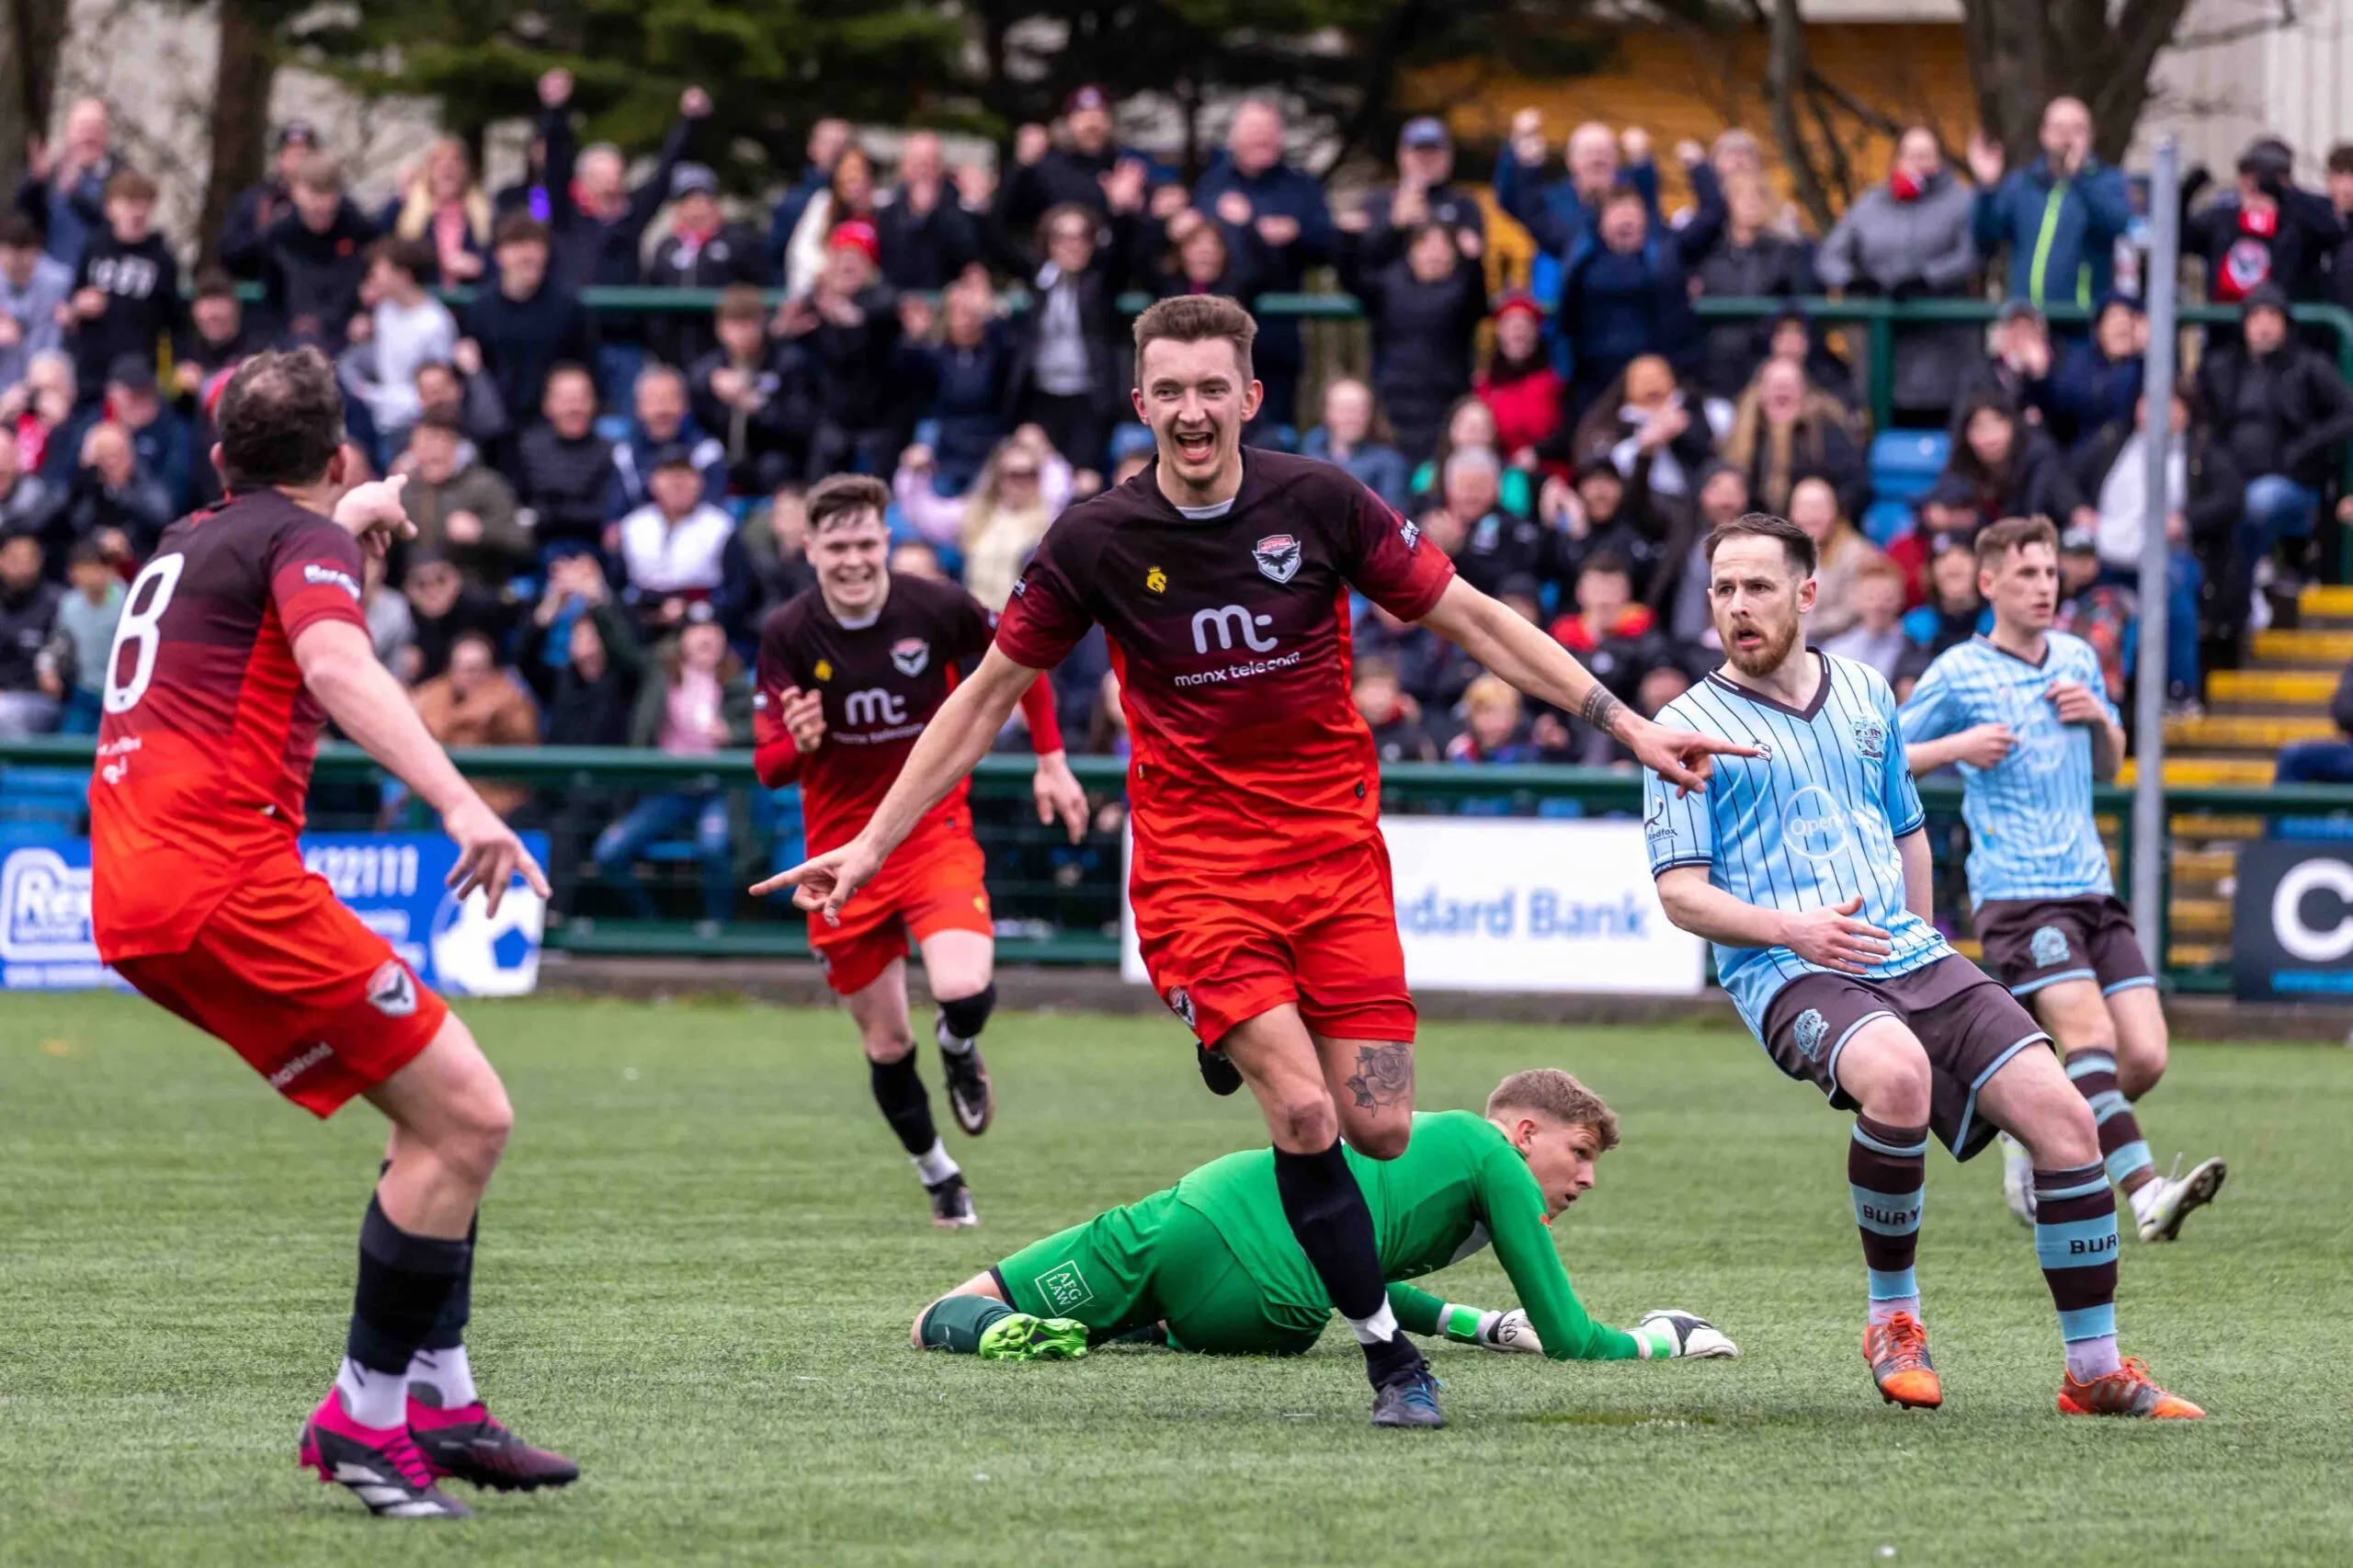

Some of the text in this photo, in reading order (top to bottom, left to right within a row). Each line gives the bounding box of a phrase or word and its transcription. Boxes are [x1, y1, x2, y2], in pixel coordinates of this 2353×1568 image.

[105, 552, 185, 714] 8
[1175, 652, 1301, 687] manx telecom
[1529, 890, 1650, 936] Bank
[1863, 1204, 1921, 1225] BURY
[2069, 1233, 2118, 1255] BUR
[1045, 1275, 1072, 1305] LAW
[1057, 1272, 1082, 1300] AFG
